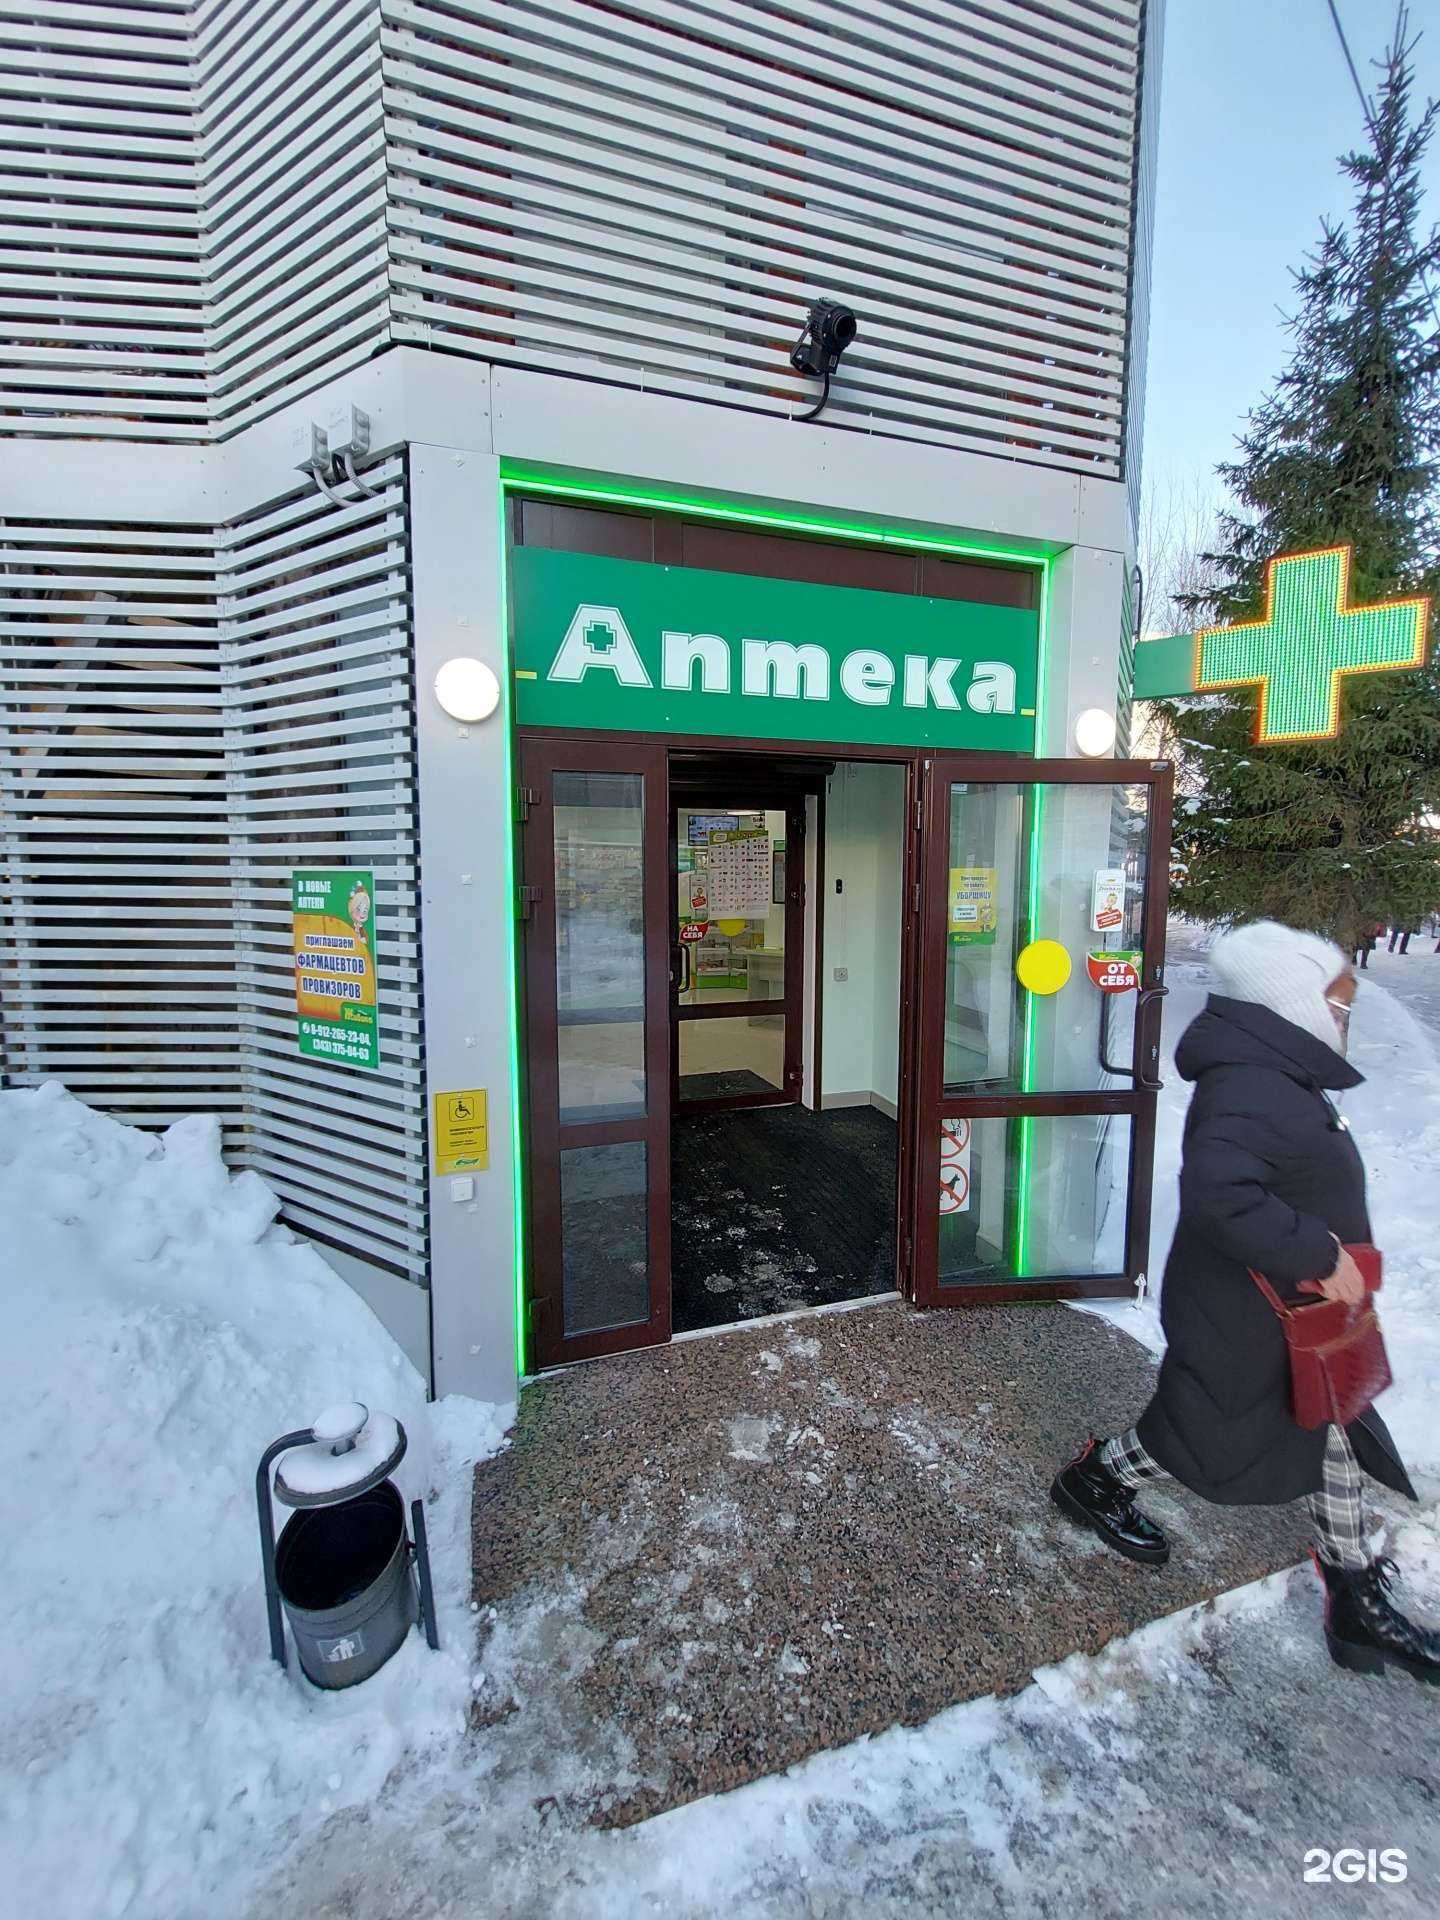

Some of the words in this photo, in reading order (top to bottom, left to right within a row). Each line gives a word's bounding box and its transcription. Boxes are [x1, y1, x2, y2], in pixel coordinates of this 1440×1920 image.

[547, 603, 1016, 715] Аптека
[305, 880, 332, 893] НОВЫЕ
[957, 891, 992, 900] УБОРЩИЦУ
[682, 931, 703, 939] СЕБЯ
[305, 935, 354, 949] приглашаем
[297, 953, 365, 974] ФАРМАЦЕВТОВ
[1107, 963, 1128, 975] ОТ
[1099, 974, 1135, 986] СЕБЯ
[303, 977, 361, 999] ПРОВИЗОРОВ
